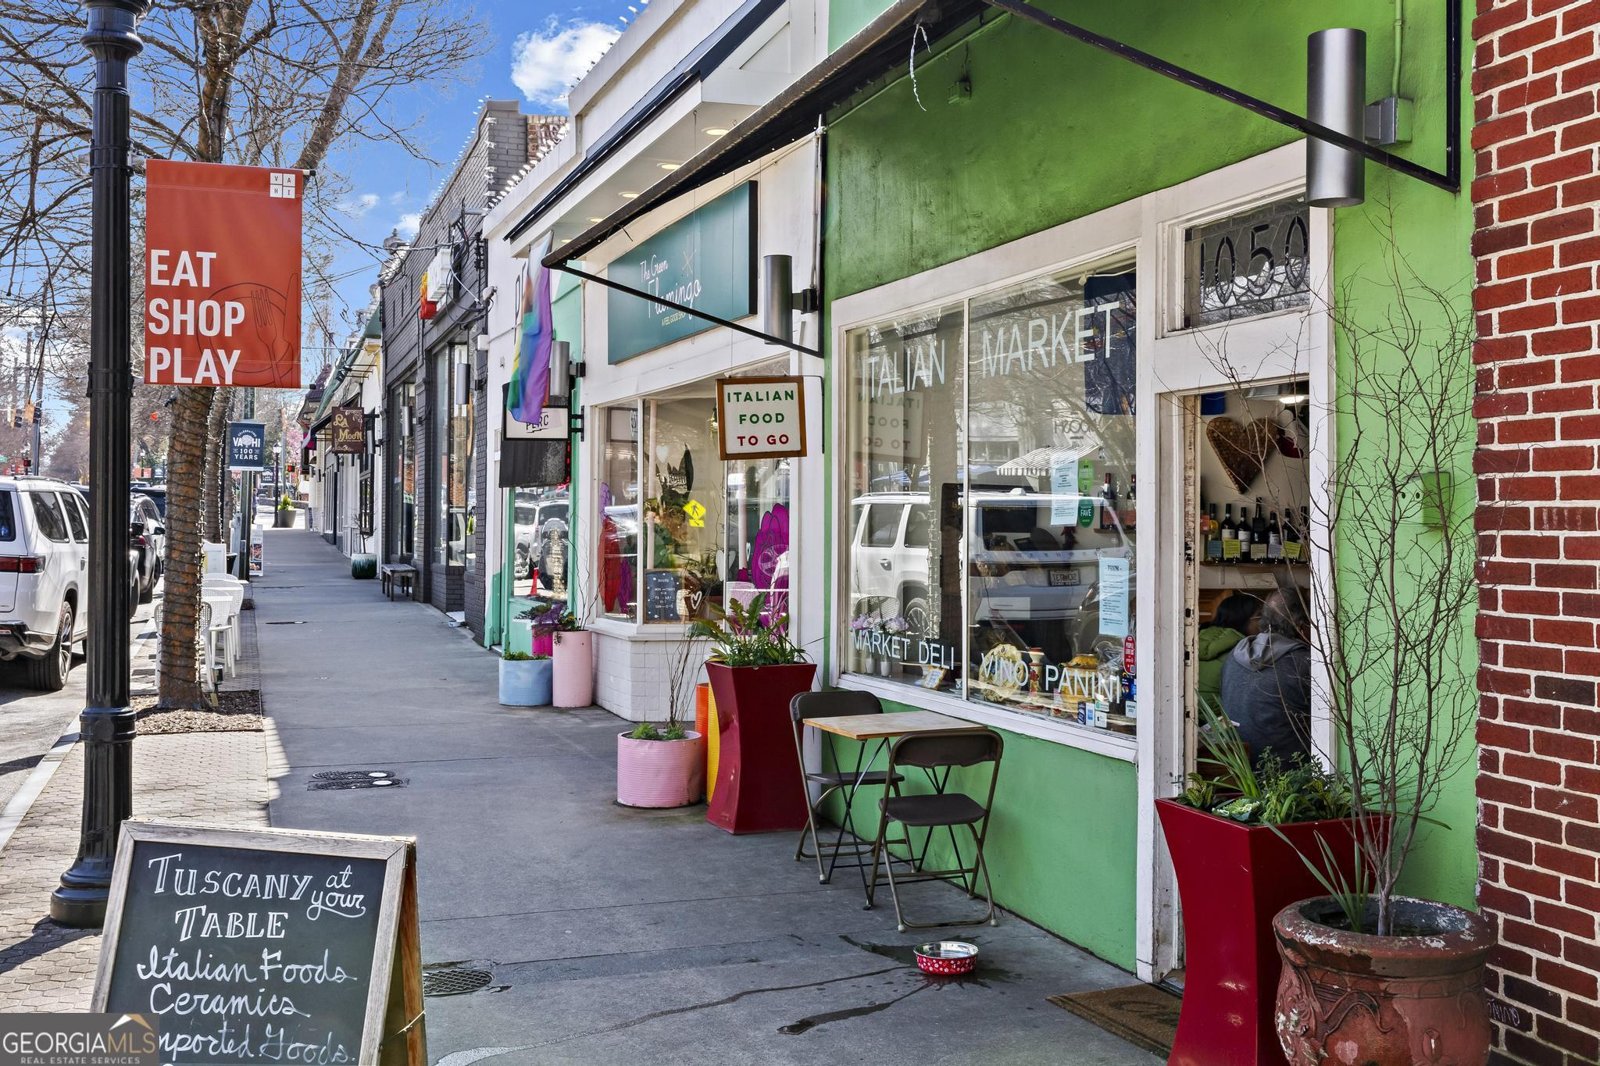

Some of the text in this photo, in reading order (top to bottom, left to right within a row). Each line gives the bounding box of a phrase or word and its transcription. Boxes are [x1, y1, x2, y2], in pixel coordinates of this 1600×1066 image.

[150, 249, 217, 288] EAT
[640, 259, 651, 283] The
[1200, 215, 1309, 308] 1050
[148, 297, 246, 337] SHOP
[149, 346, 242, 385] PLAY
[861, 301, 1121, 401] ITALIAN MARKET
[726, 389, 795, 403] ITALIAN
[738, 412, 785, 425] FOOD
[234, 453, 259, 461] YEARS
[736, 433, 790, 447] TO GO
[851, 629, 955, 671] MARKET DELI
[980, 651, 1030, 687] VINO
[1045, 664, 1121, 704] PANINI
[325, 864, 353, 889] at
[306, 890, 367, 922] your
[136, 944, 358, 984] Italian Foods
[150, 982, 312, 1018] Ceramics
